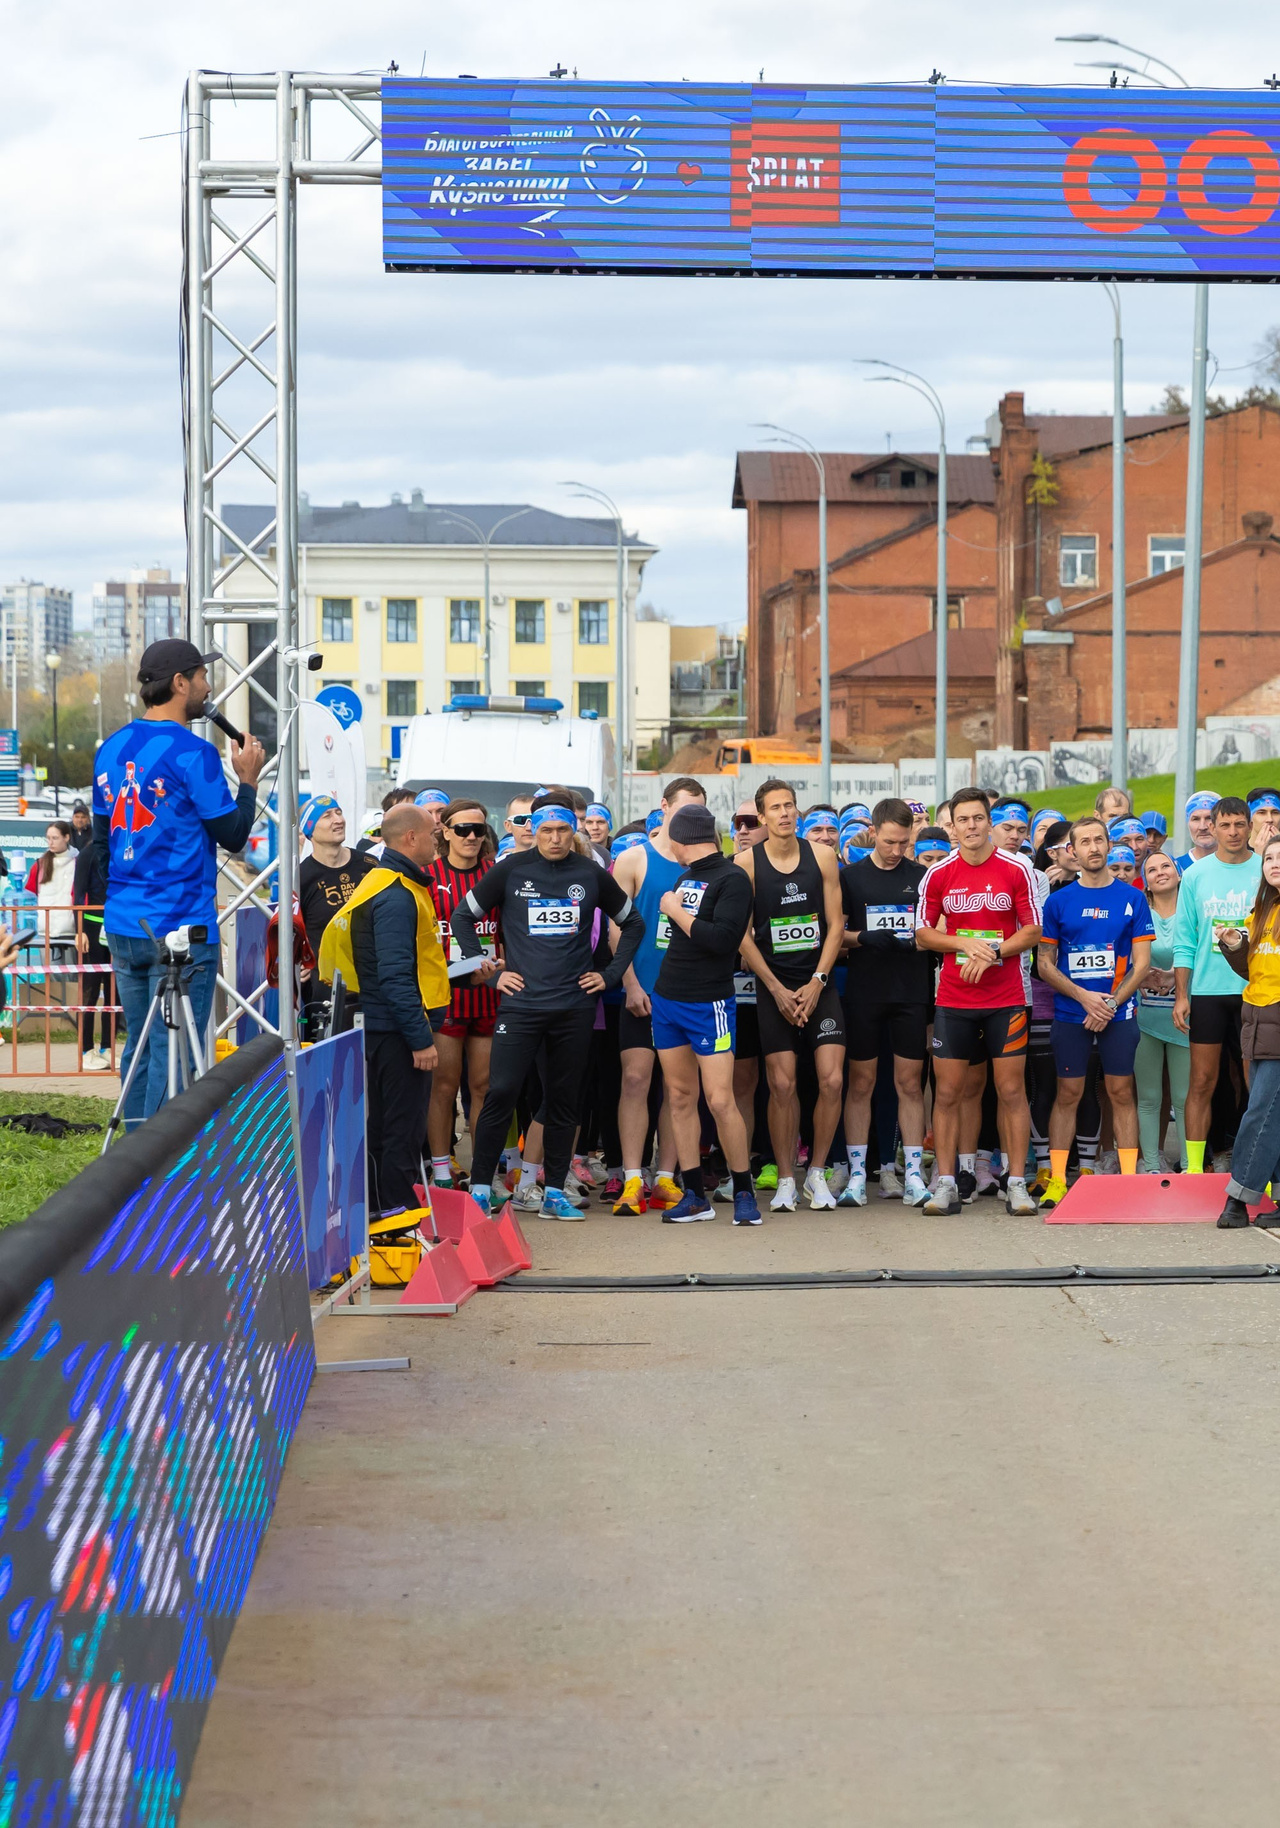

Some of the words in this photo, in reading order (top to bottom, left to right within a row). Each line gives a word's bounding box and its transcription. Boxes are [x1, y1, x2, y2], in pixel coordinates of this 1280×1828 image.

[747, 156, 824, 193] SPLAT
[536, 911, 573, 923] 433
[876, 917, 907, 928] 414
[779, 927, 815, 941] 500
[1076, 955, 1106, 967] 413
